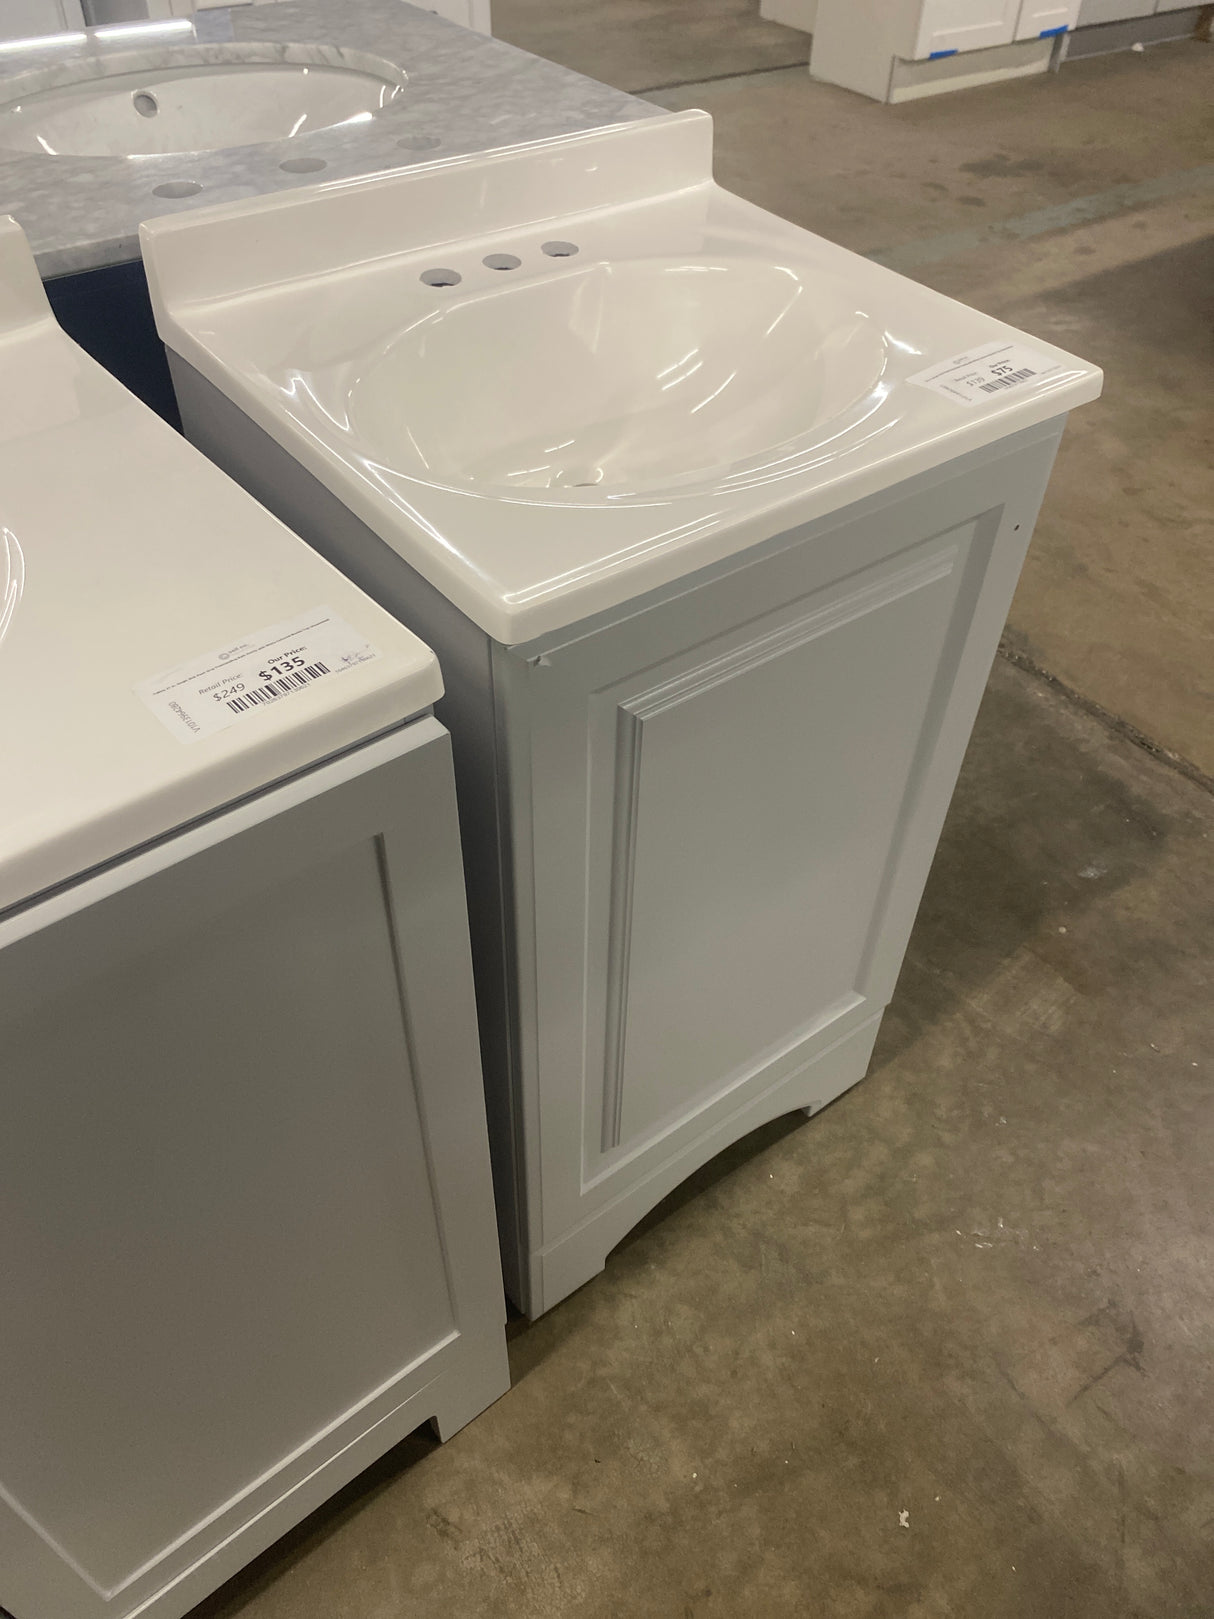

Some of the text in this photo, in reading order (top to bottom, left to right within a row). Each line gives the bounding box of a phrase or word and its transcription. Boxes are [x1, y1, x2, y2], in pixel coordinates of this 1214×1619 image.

[991, 365, 1013, 376] $75
[267, 656, 283, 665] Our
[283, 646, 308, 658] Price:
[258, 656, 306, 682] $135
[198, 682, 222, 695] Retail
[212, 682, 246, 702] $249
